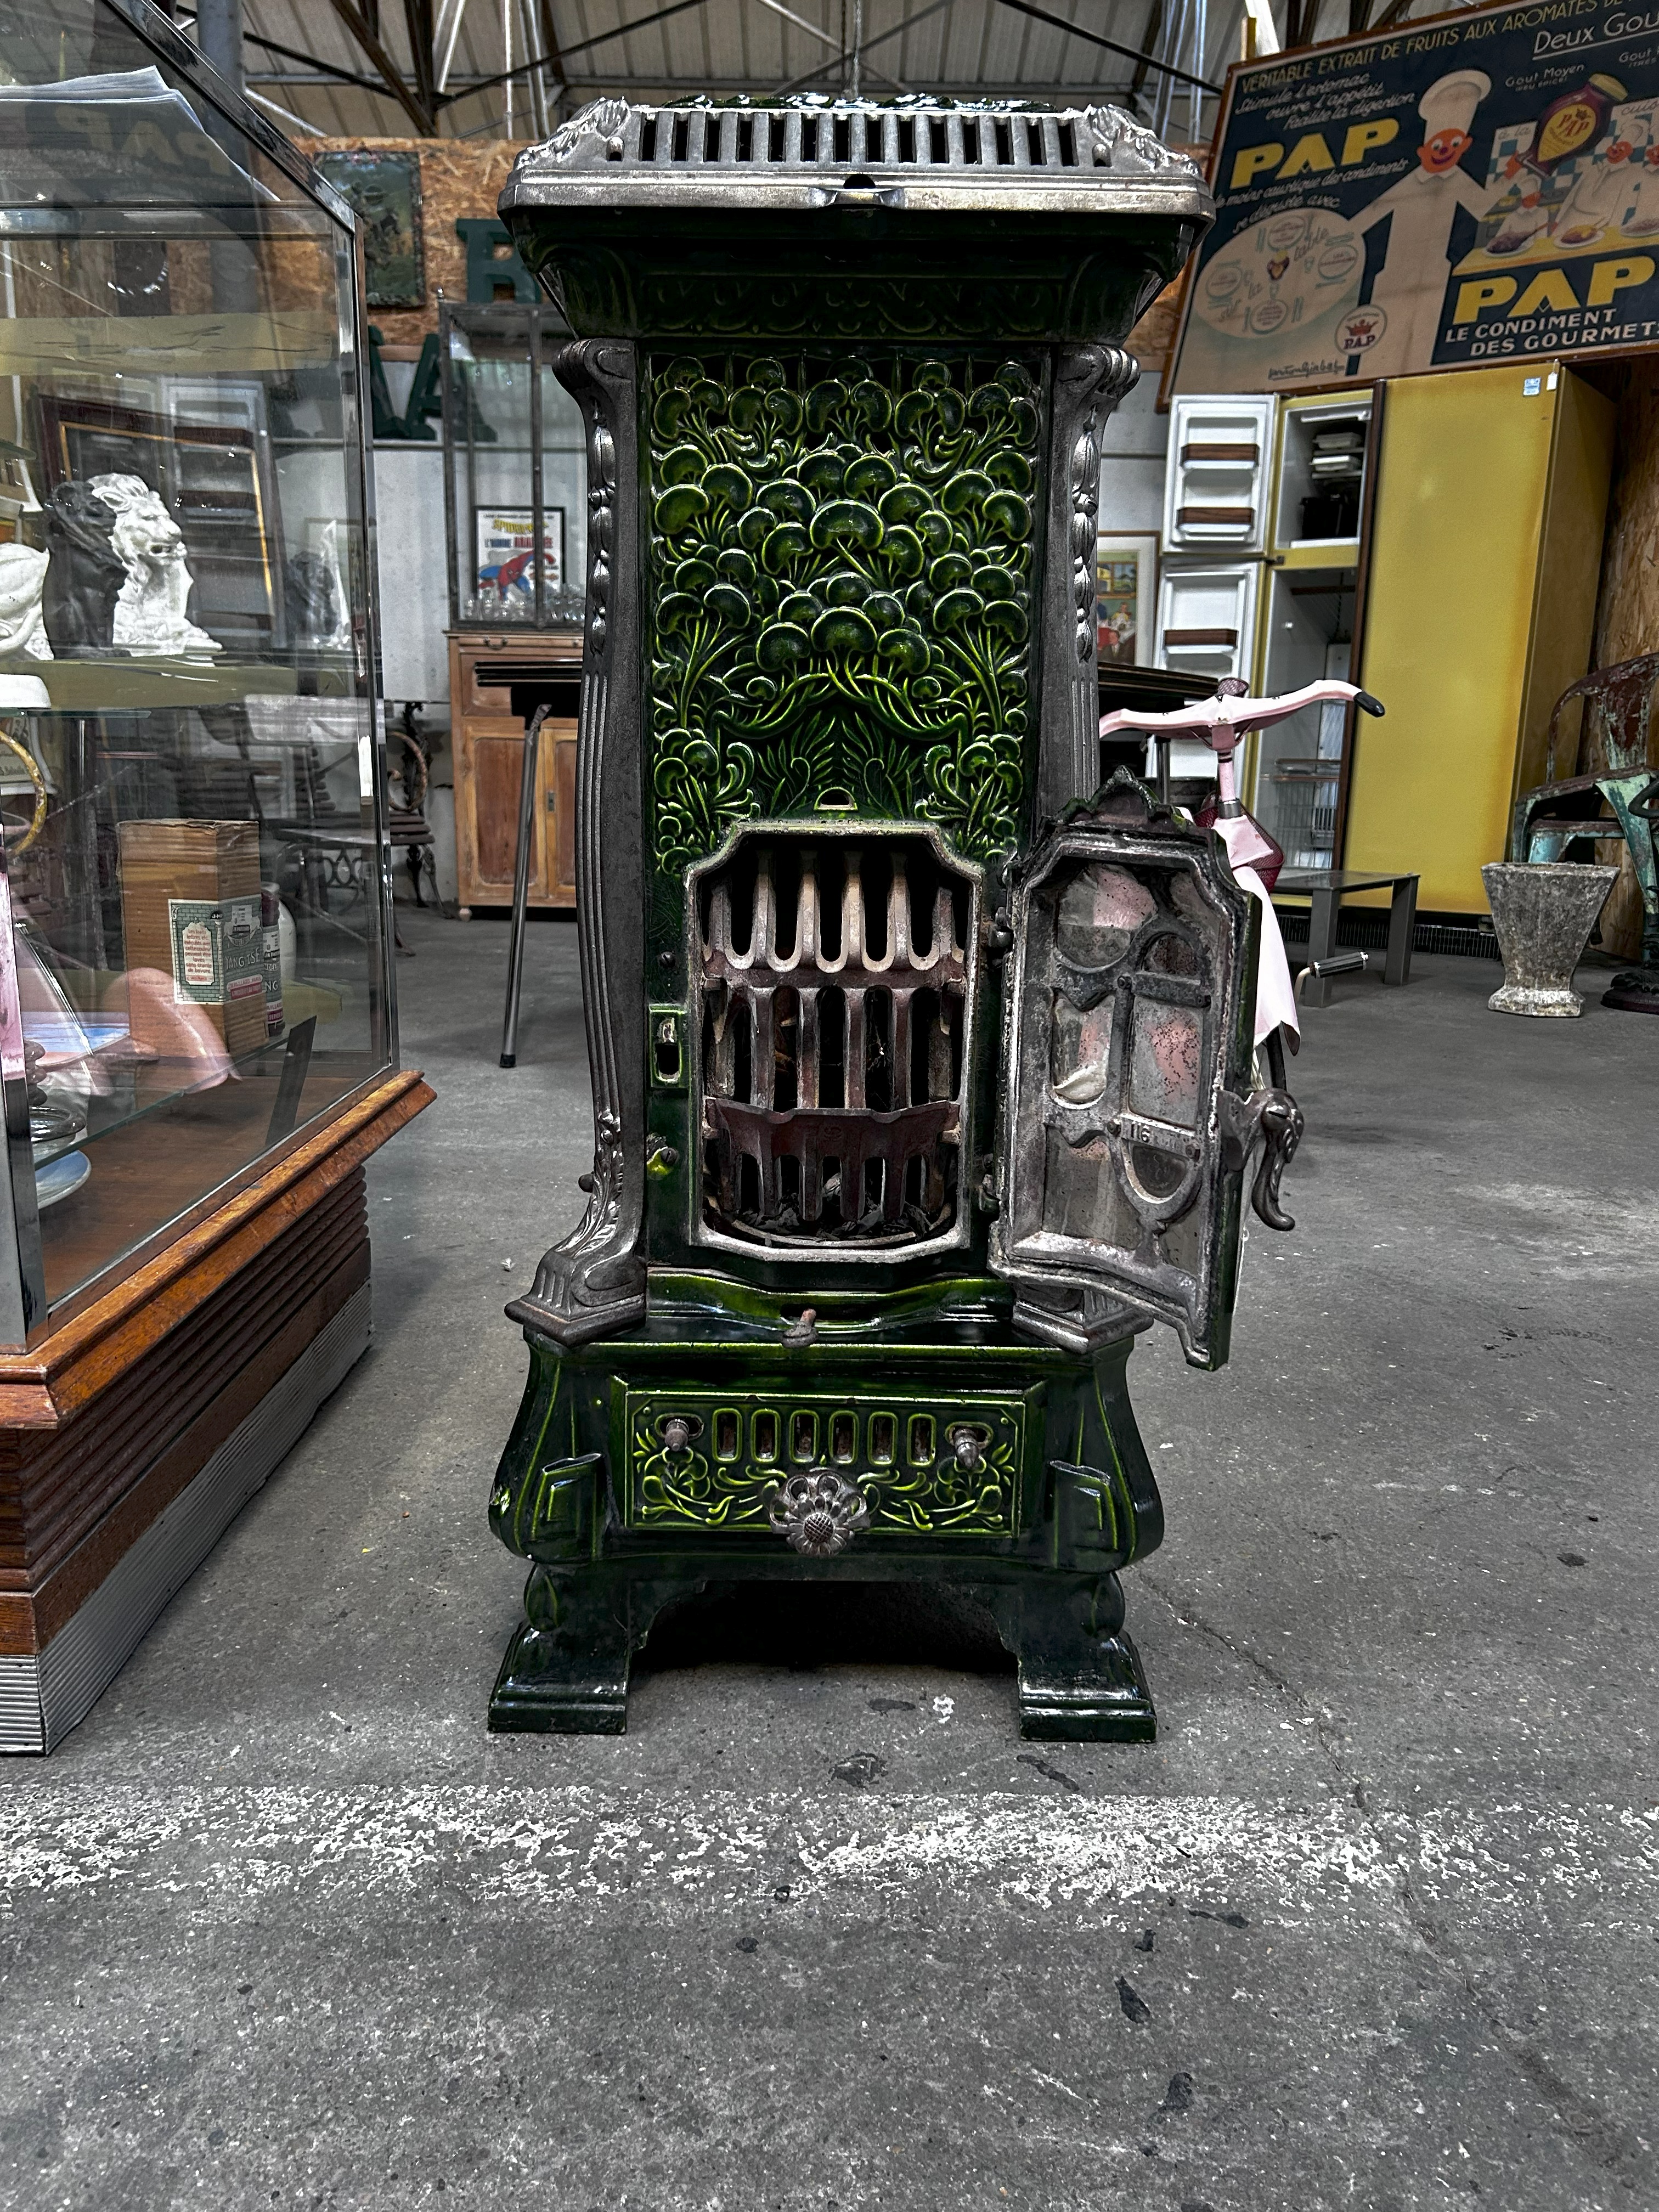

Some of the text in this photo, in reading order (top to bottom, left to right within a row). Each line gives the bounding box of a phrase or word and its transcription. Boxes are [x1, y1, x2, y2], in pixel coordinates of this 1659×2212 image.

[1318, 47, 1378, 75] EXTRAIT
[1381, 44, 1400, 60] DE
[1406, 28, 1459, 54] FRUITS
[1464, 19, 1497, 42] AUX
[1501, 0, 1597, 37] AROMATES
[1533, 26, 1595, 54] Deux
[1543, 64, 1585, 79] Moyen
[1235, 88, 1293, 115] Stimule
[1229, 118, 1400, 190] PAP
[1307, 195, 1341, 208] avec
[1453, 256, 1656, 325] PAP
[1445, 308, 1617, 343] LE CONDIMENT
[1470, 320, 1659, 356] DES GOURMET
[225, 955, 245, 970] YANG
